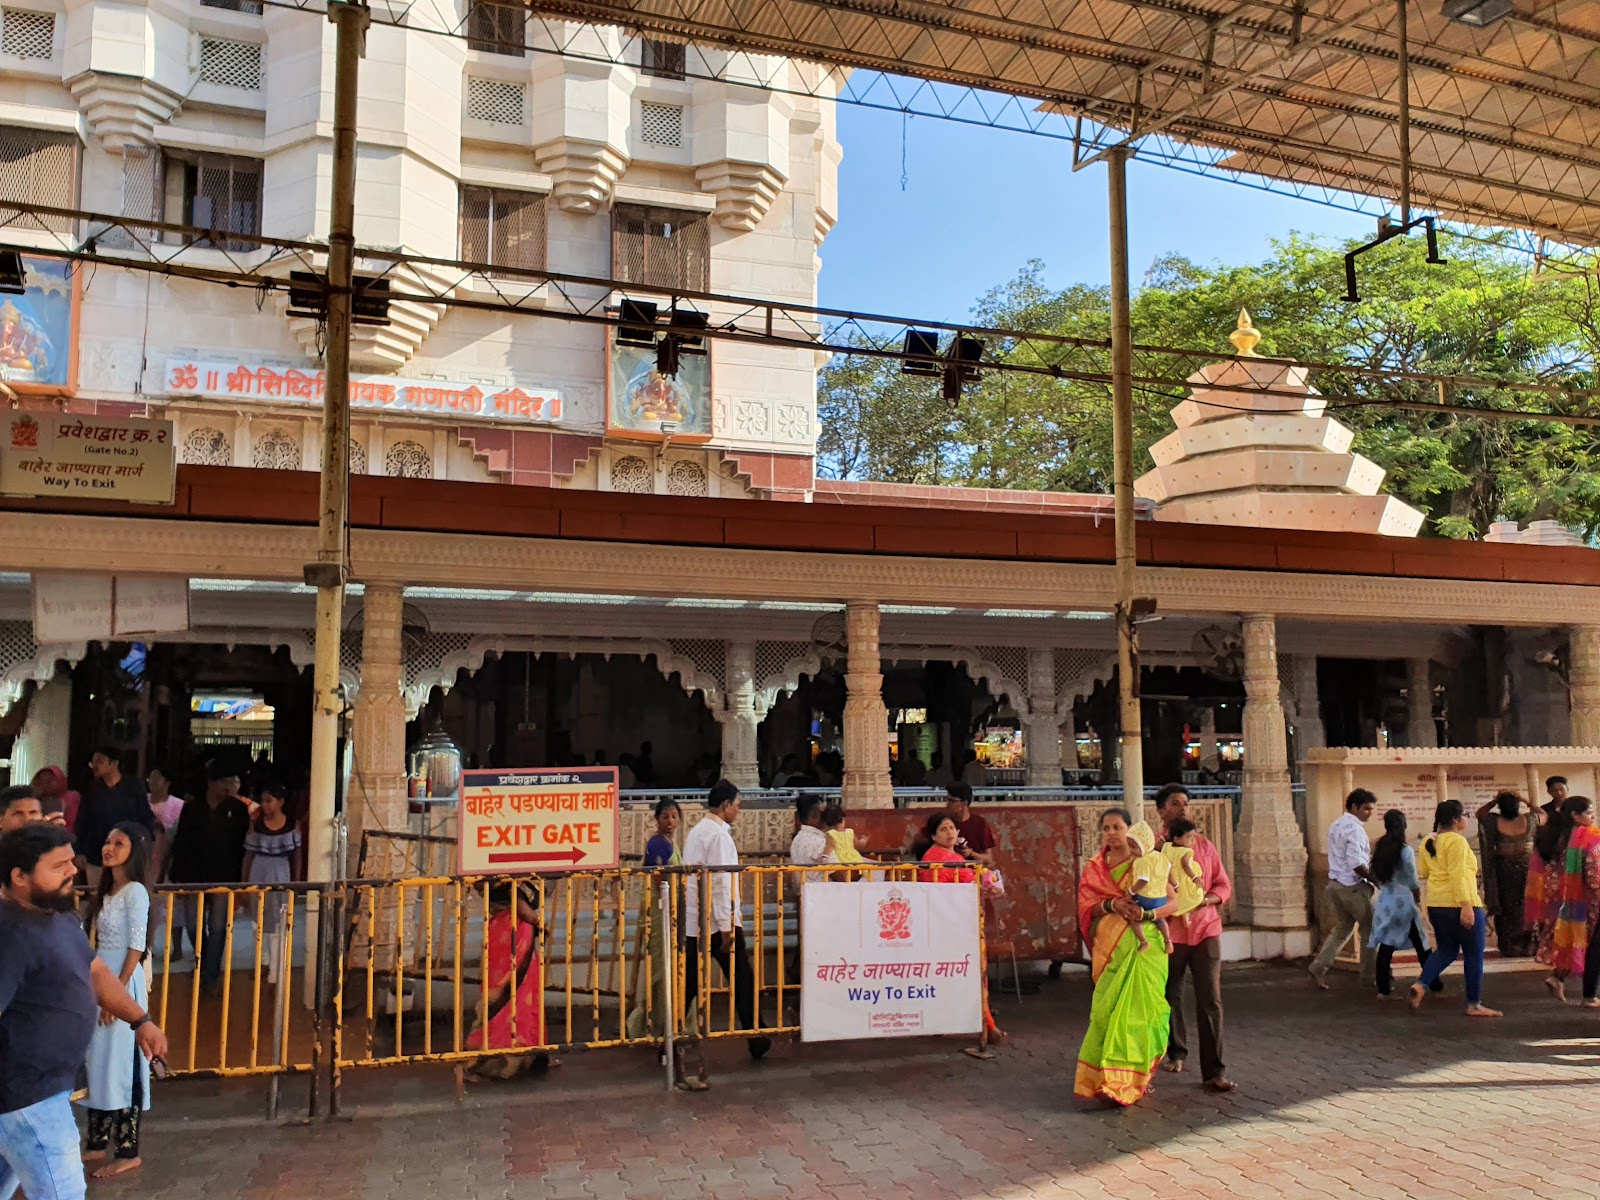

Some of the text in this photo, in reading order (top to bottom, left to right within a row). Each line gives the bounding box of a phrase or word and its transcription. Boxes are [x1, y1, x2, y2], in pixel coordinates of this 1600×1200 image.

[404, 384, 484, 412] गणपती
[493, 387, 545, 418] मंदिर
[56, 419, 128, 444] प्रवेशद्वार
[84, 445, 139, 457] (Gate No.2)
[18, 457, 144, 478] बाहेर जाण्याचा मार्ग
[44, 476, 116, 489] Way To Exit
[540, 772, 570, 784] क्रमांक
[465, 784, 615, 818] बाहेर पडण्याचा मार्ग
[477, 822, 601, 848] EXIT GATE
[816, 953, 971, 984] बाहेर जाण्याचा मार्ग
[848, 984, 936, 1004] Way To Exit
